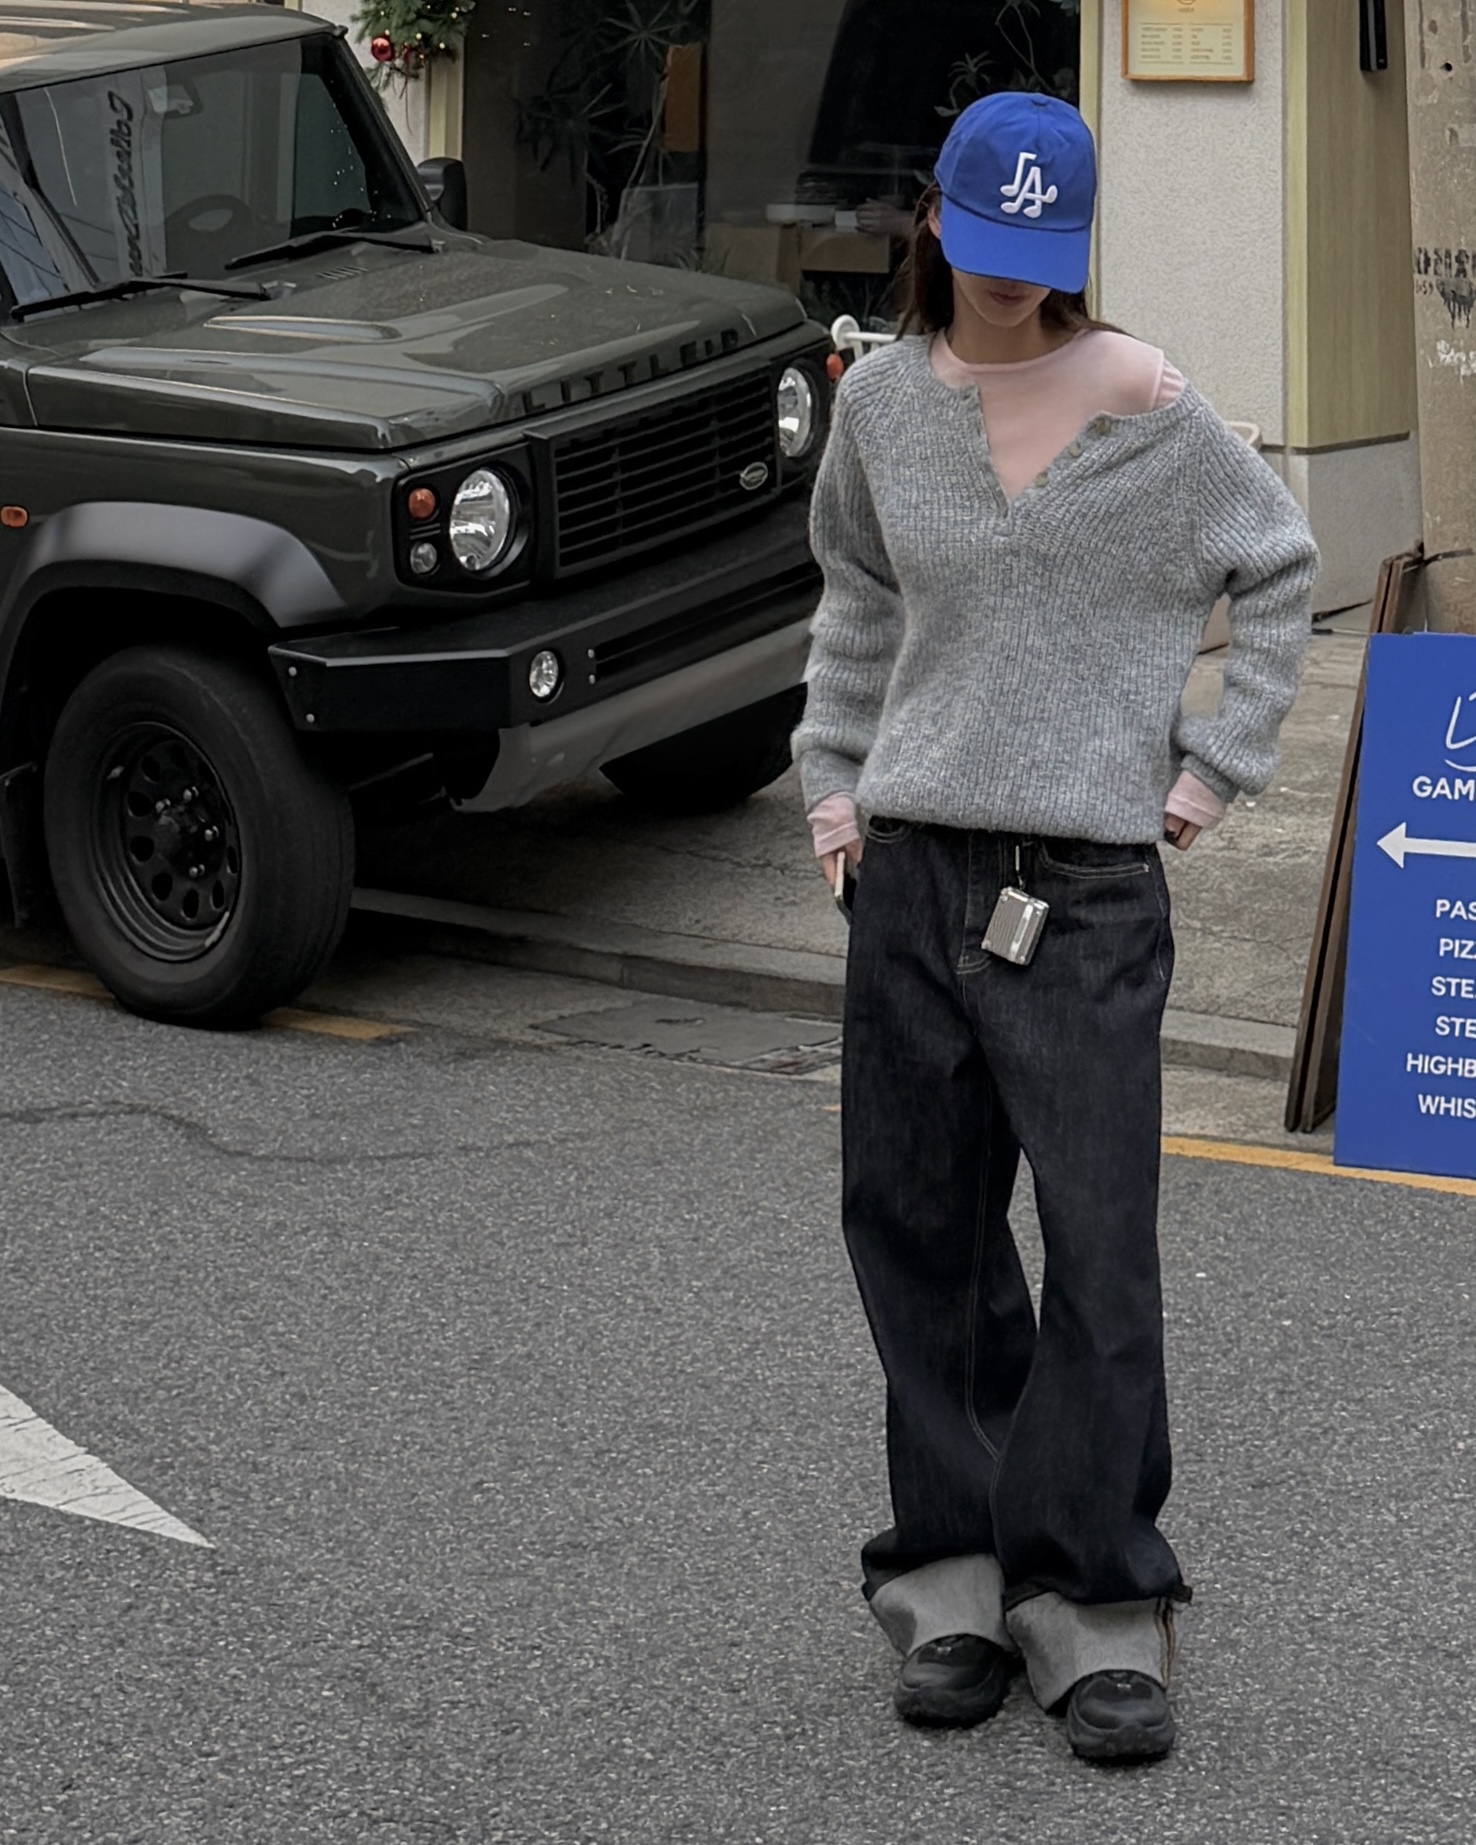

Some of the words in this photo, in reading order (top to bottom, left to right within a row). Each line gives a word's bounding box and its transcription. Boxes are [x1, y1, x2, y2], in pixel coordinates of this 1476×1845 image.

[1412, 775, 1476, 801] GAM
[1439, 938, 1476, 959] PIZ
[1431, 976, 1476, 998] STE
[1435, 1015, 1476, 1039] STE
[1406, 1052, 1476, 1078] HIGHB
[1417, 1094, 1476, 1119] WHIS
